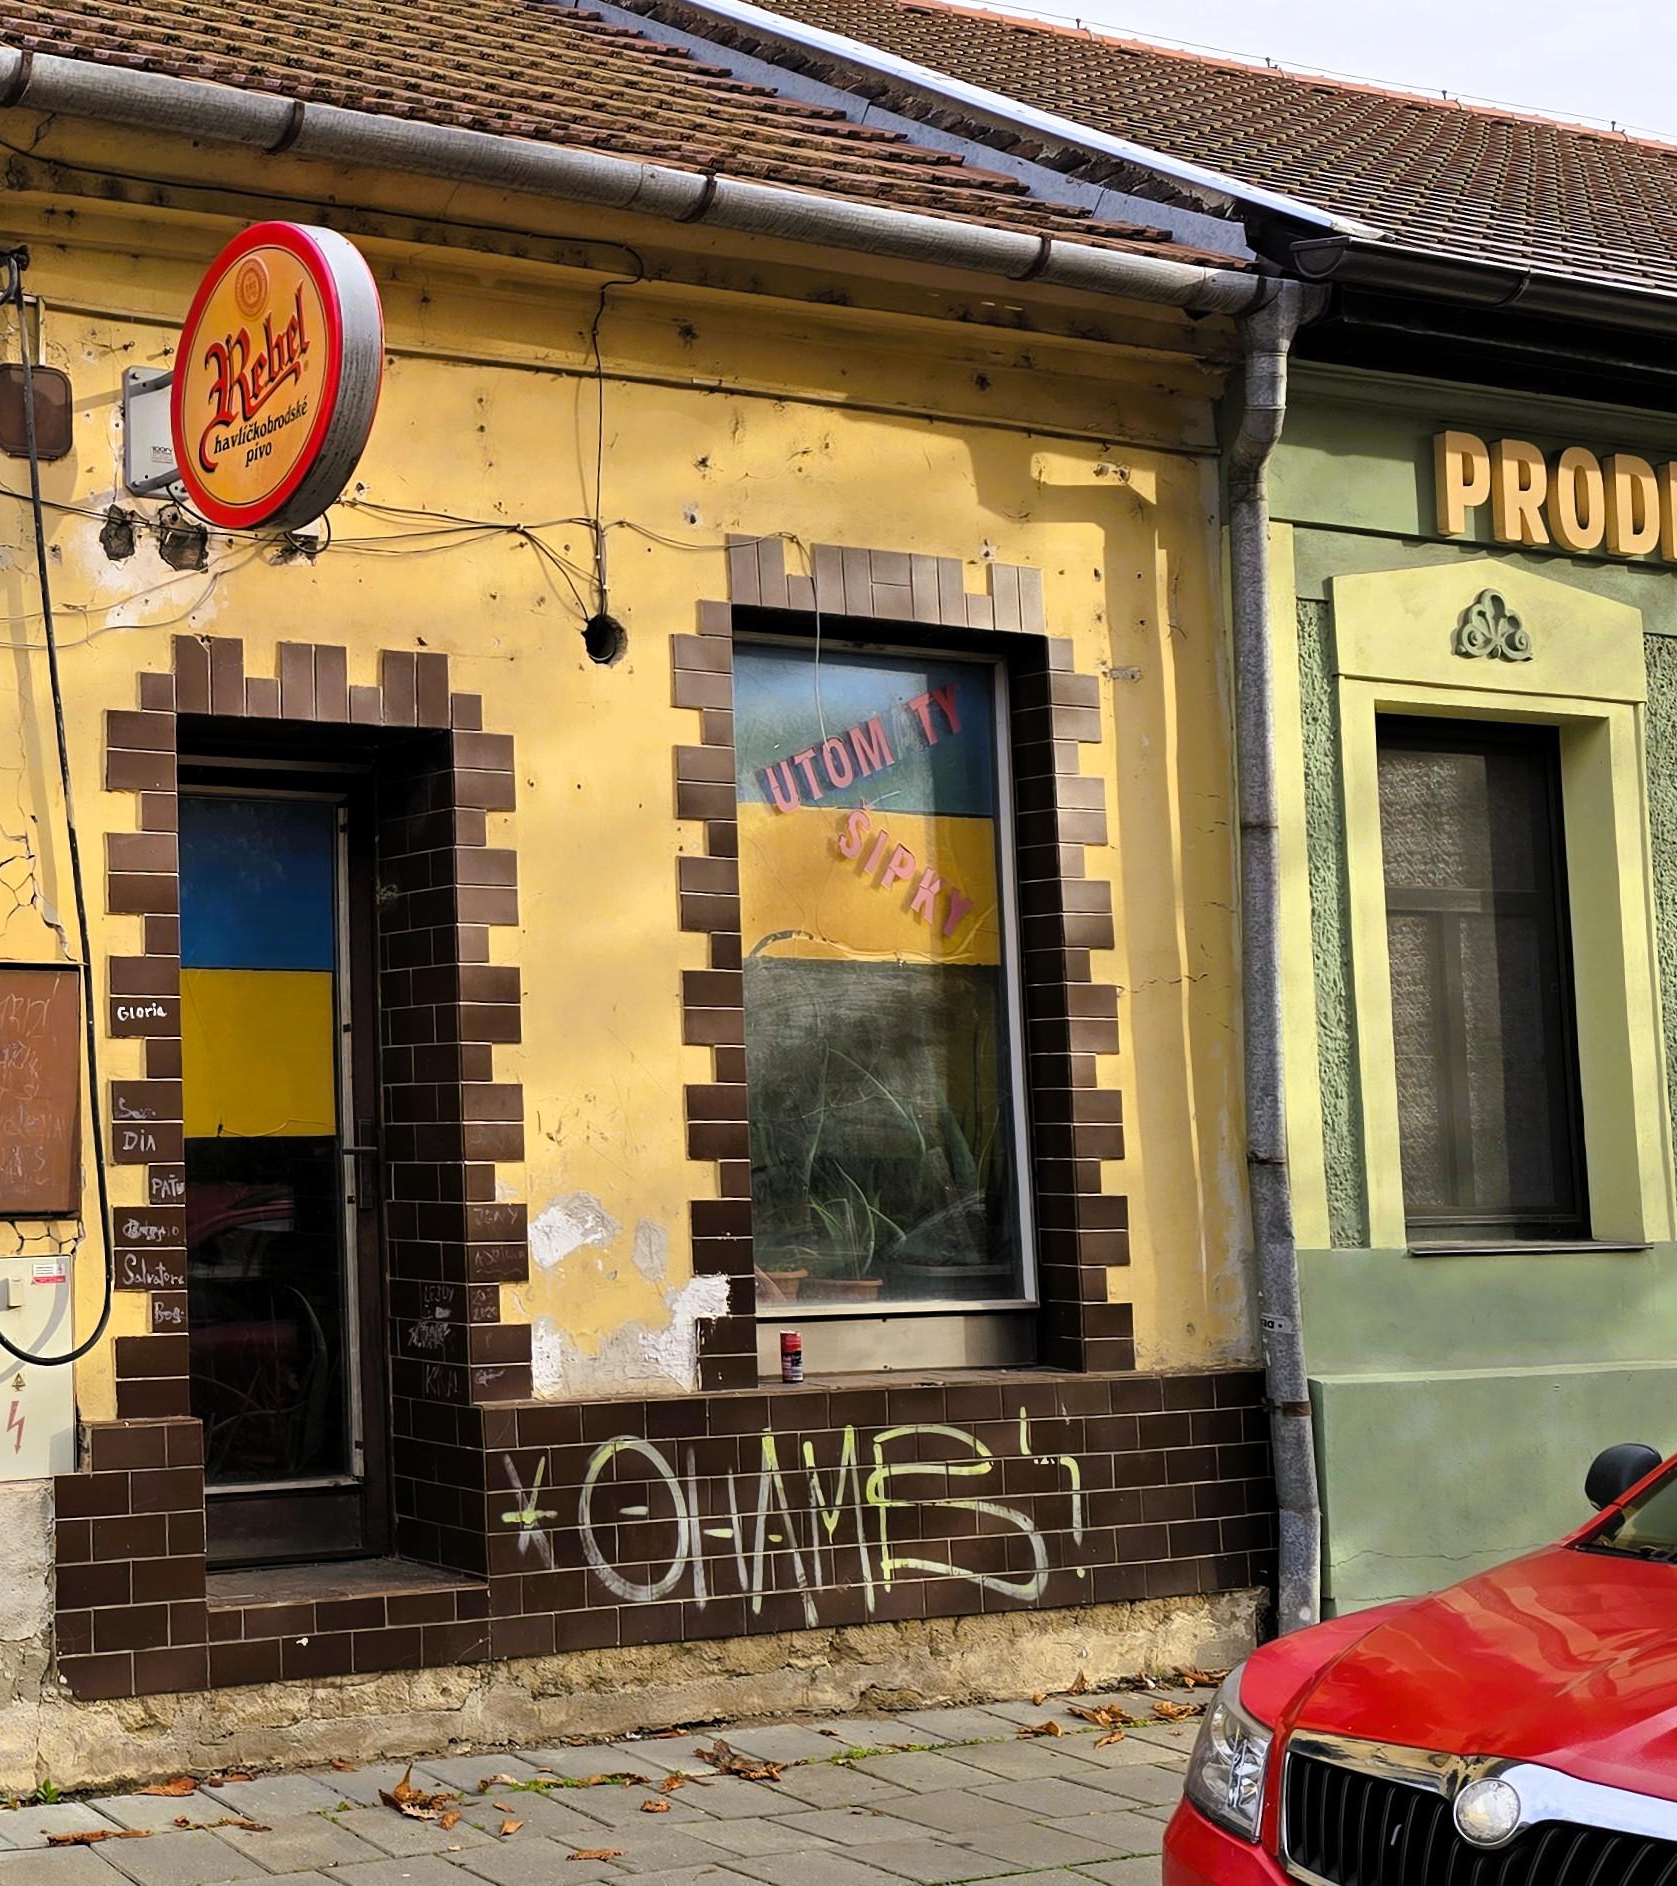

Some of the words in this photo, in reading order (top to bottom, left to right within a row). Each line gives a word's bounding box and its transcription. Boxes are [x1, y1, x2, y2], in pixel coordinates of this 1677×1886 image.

[200, 278, 310, 455] Rebel
[213, 395, 308, 454] havlíčkobrodské
[245, 441, 273, 467] pivo
[117, 1003, 167, 1021] Gloria
